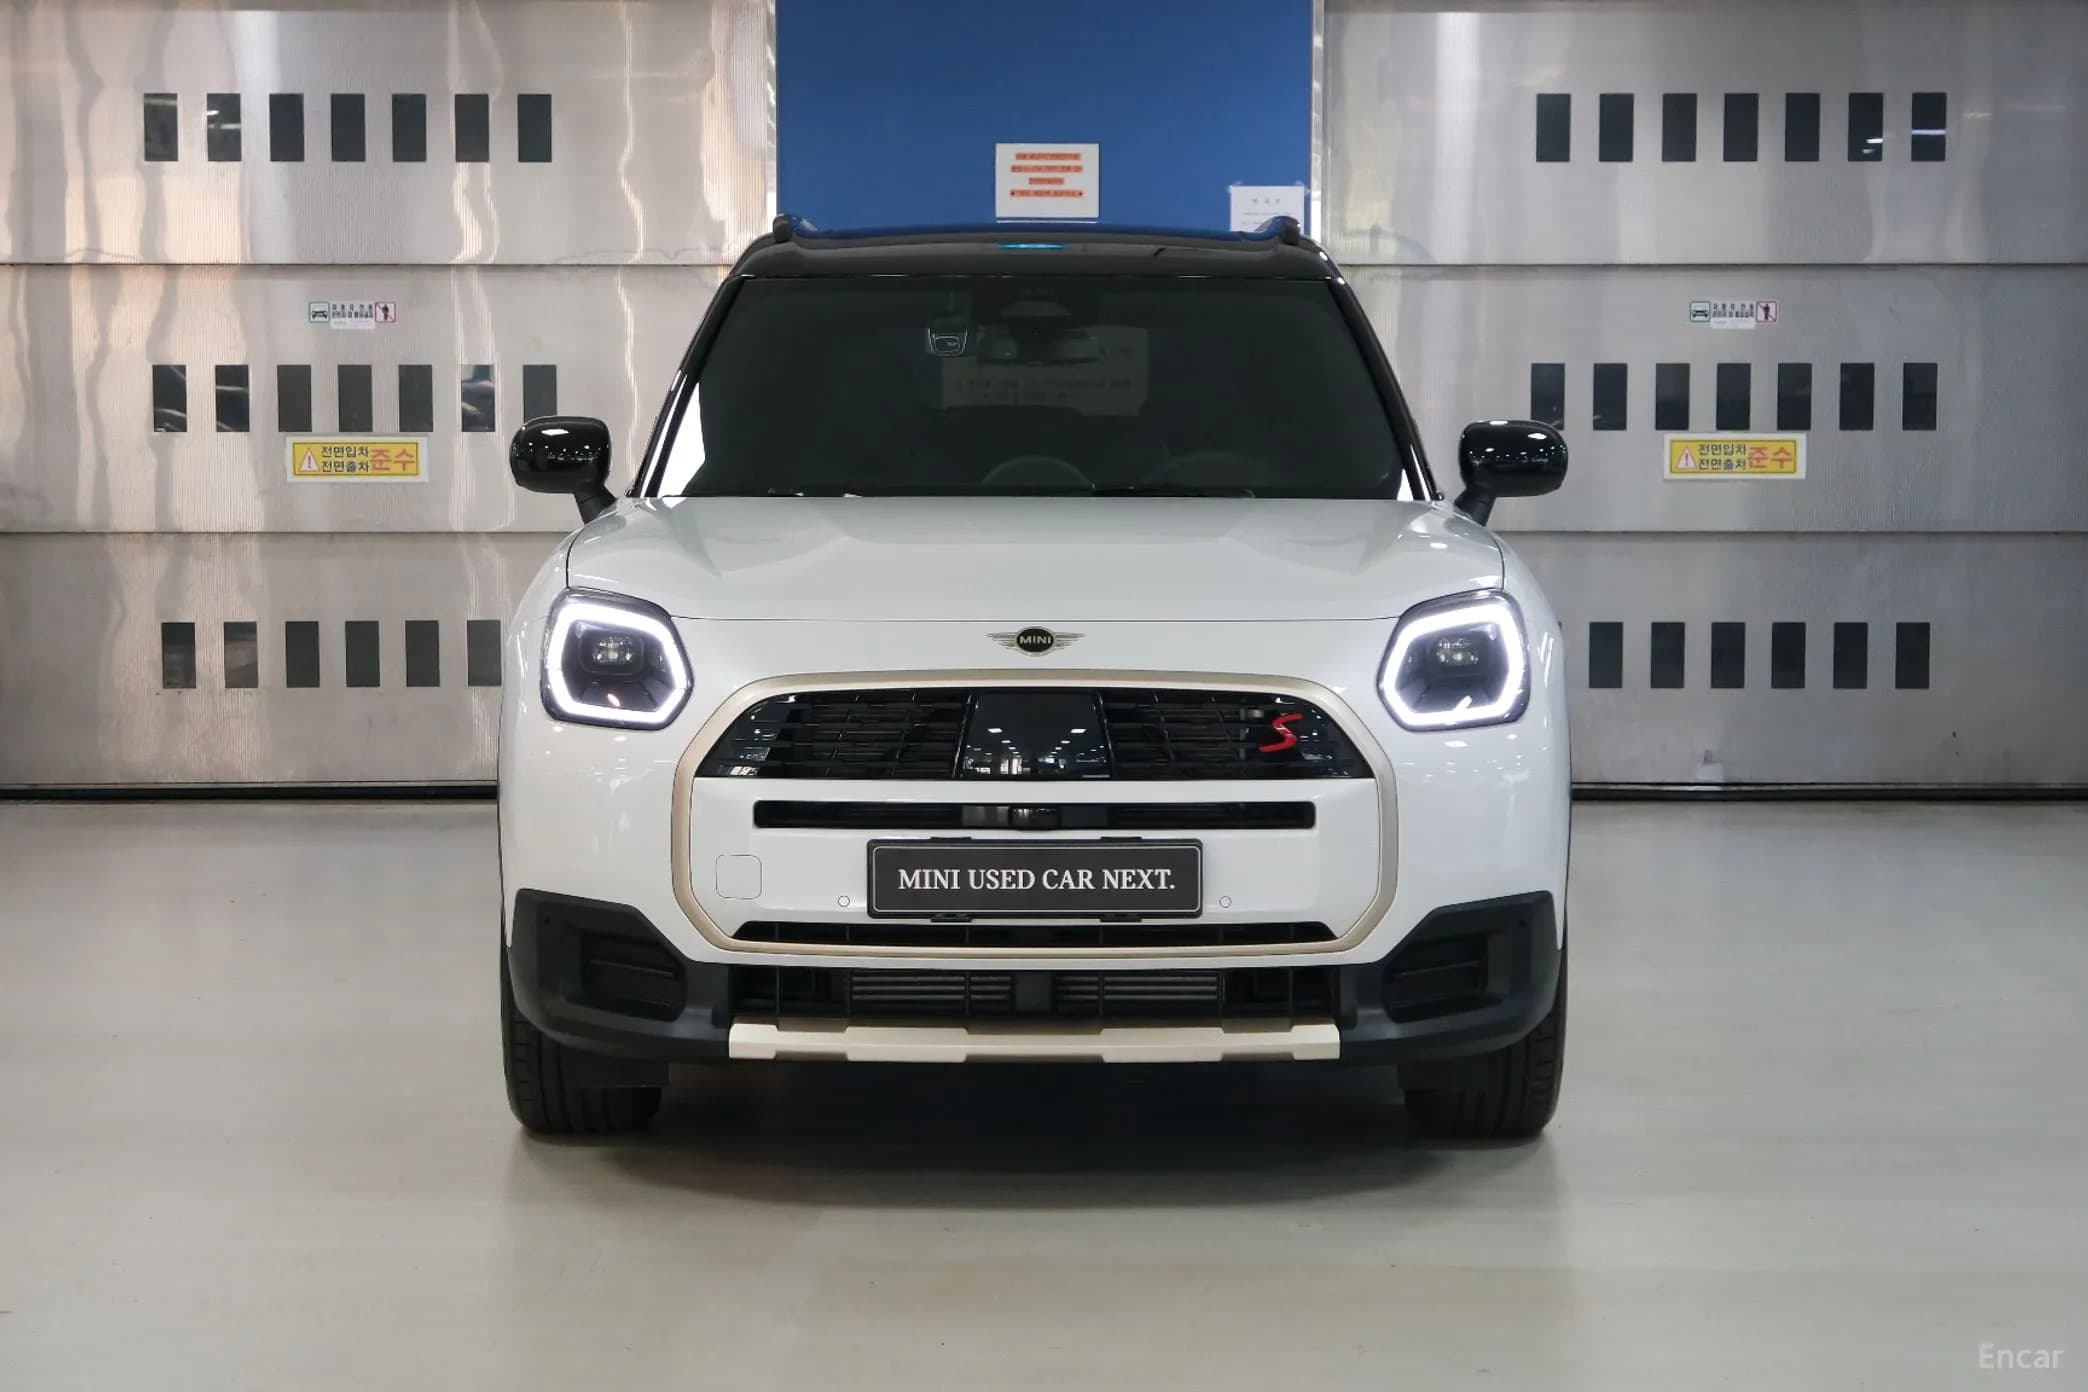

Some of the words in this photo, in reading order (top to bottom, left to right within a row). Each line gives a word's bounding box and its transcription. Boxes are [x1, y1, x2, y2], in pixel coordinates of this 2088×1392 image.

[321, 446, 369, 458] 전면입차
[1699, 444, 1746, 456] 전면입차
[1748, 446, 1793, 469] 준수
[370, 448, 415, 471] 준수
[1020, 635, 1052, 644] MINI
[898, 869, 960, 889] MINI
[968, 869, 1035, 890] USED
[1042, 869, 1096, 890] CAR
[1102, 869, 1176, 890] NEXT.
